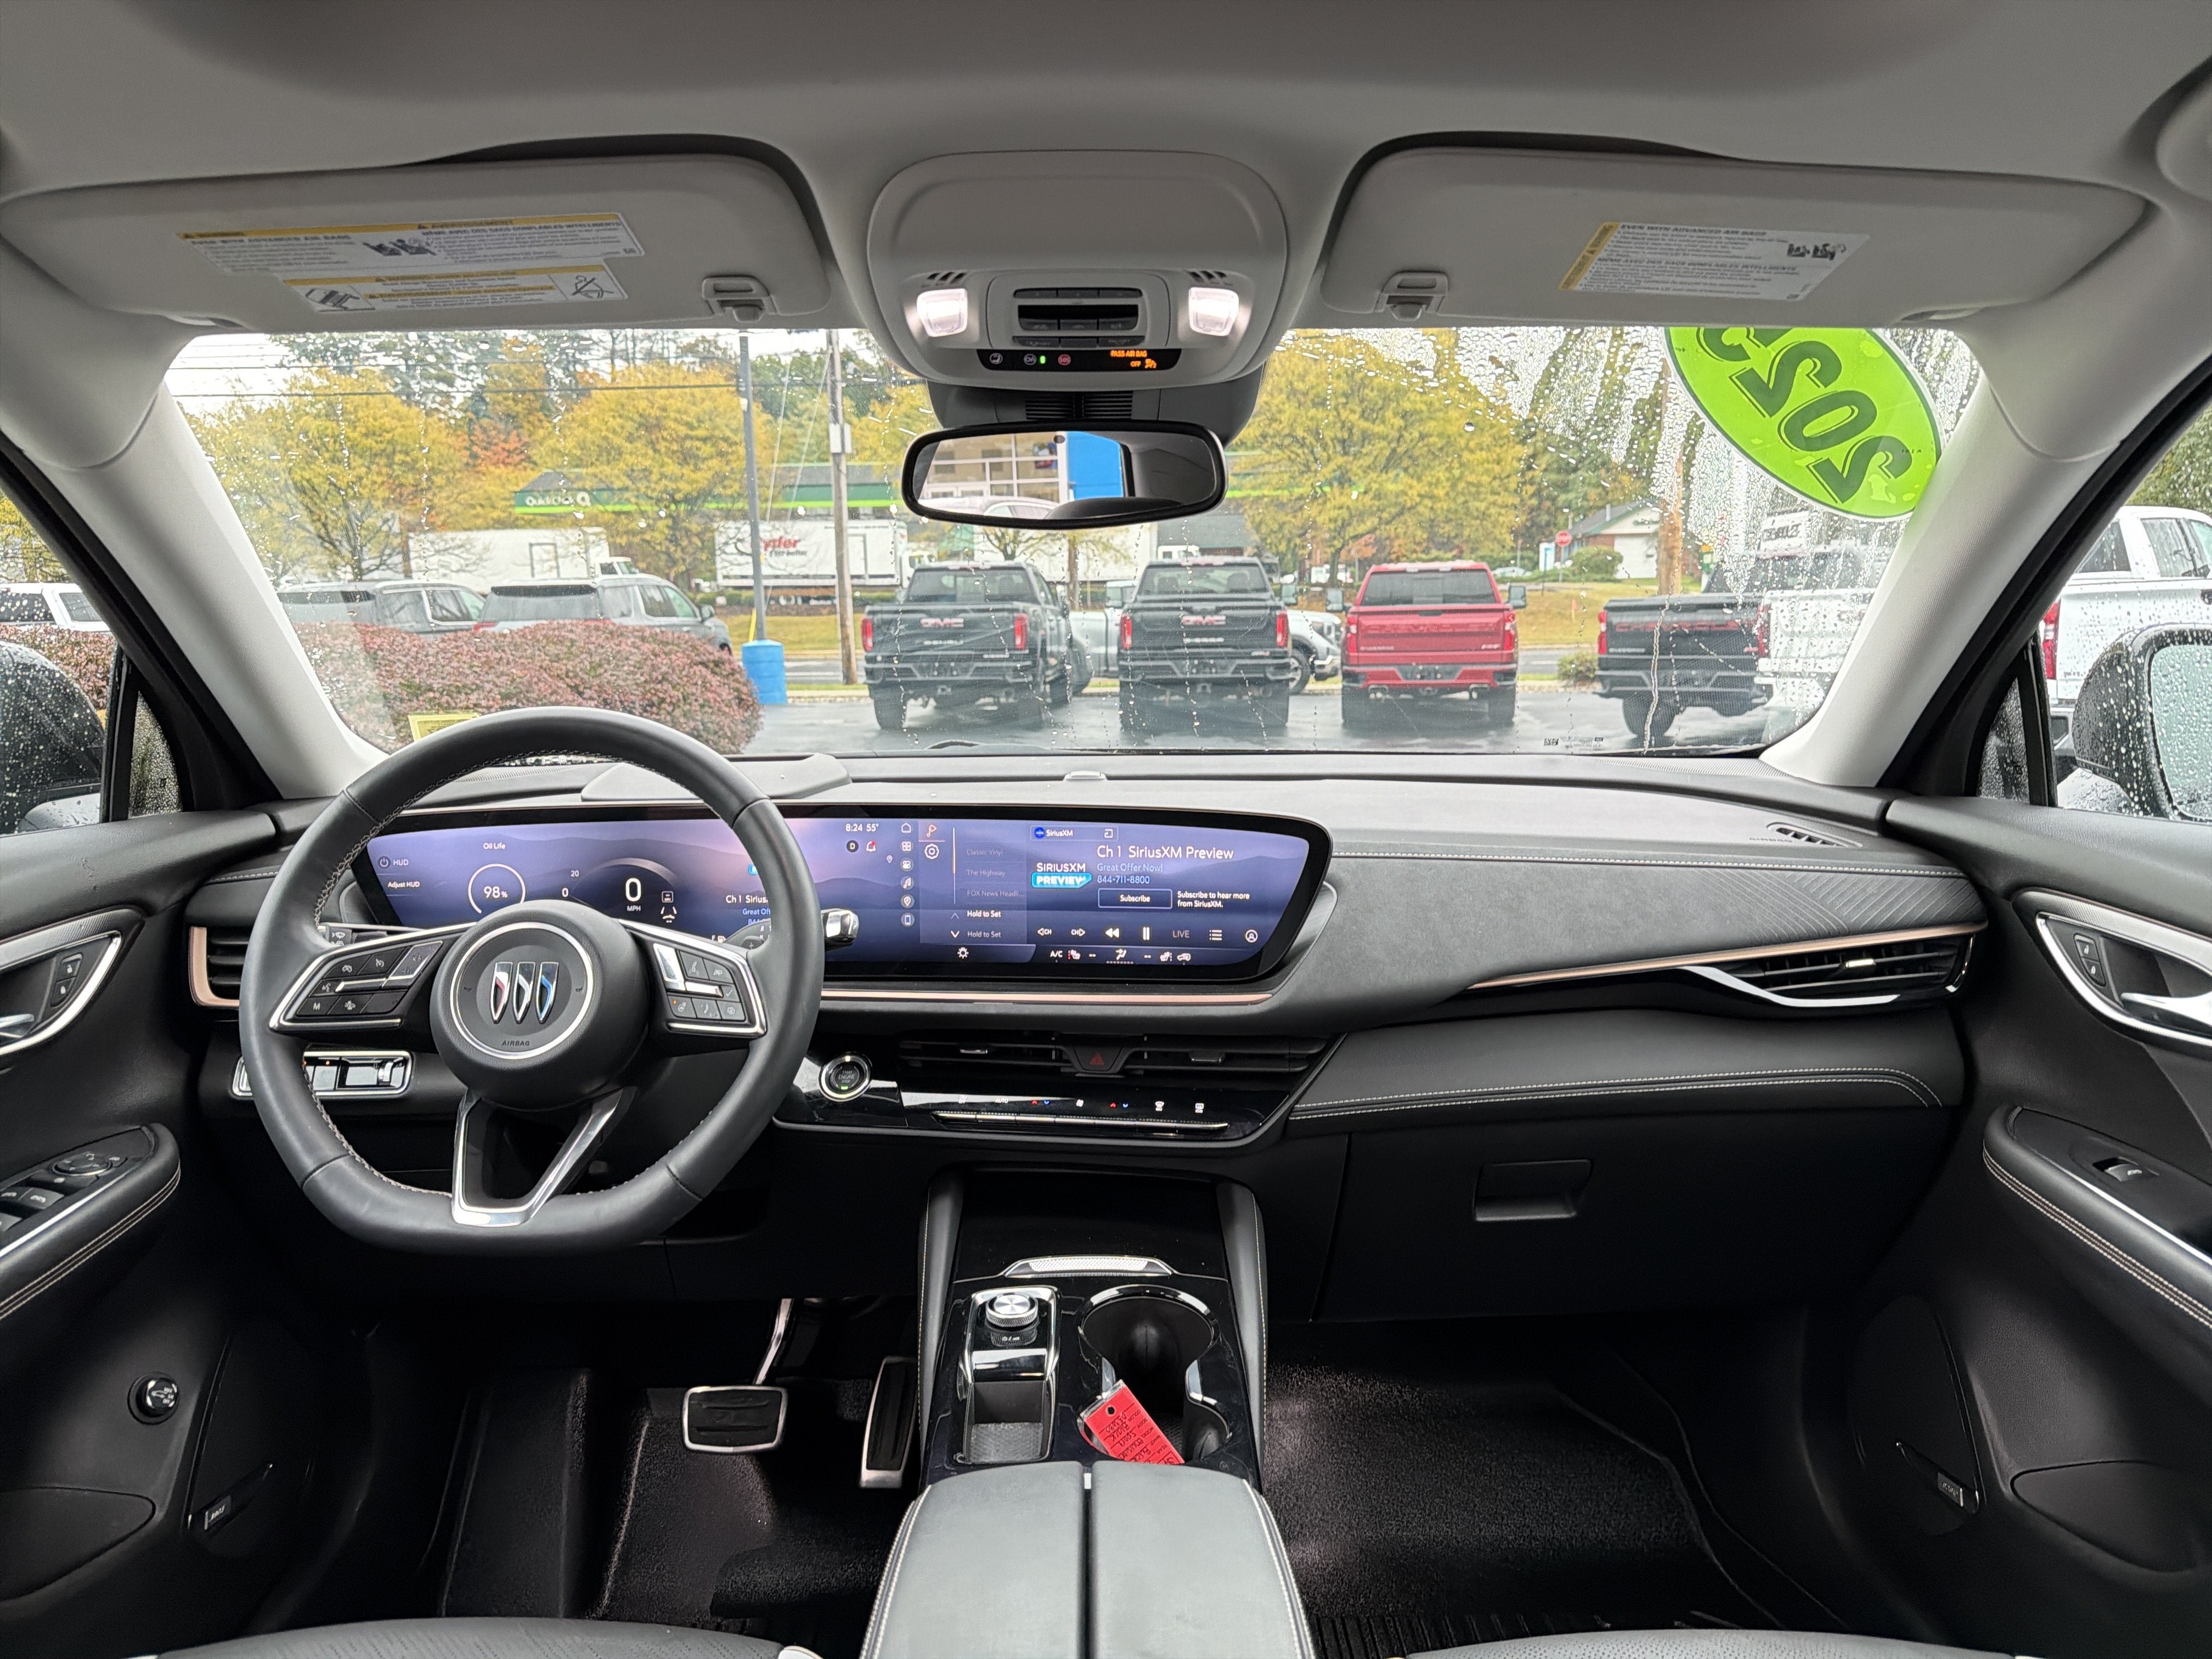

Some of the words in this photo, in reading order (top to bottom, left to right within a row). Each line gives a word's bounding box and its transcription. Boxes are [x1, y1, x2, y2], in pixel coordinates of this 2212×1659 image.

[752, 535, 802, 551] yder
[921, 618, 964, 627] GMC
[1182, 616, 1226, 625] GMC
[845, 823, 863, 832] 8:24
[866, 823, 879, 832] 55°
[1097, 845, 1113, 858] Ch
[1117, 845, 1121, 857] 1
[1128, 845, 1182, 859] SiriusXM
[1186, 846, 1234, 859] Preview
[1036, 862, 1086, 872] SIRIUSXM
[1097, 863, 1118, 871] Great
[1120, 863, 1141, 872] Offer
[1143, 864, 1163, 872] Now!
[979, 870, 1005, 878] Highway
[1036, 876, 1086, 885] PREVIEW
[1097, 876, 1150, 884] 844-711-8800
[562, 888, 568, 897] 0
[625, 878, 641, 901] 0
[726, 895, 737, 904] Ch
[738, 895, 742, 903] 1
[1173, 930, 1189, 938] LIVE
